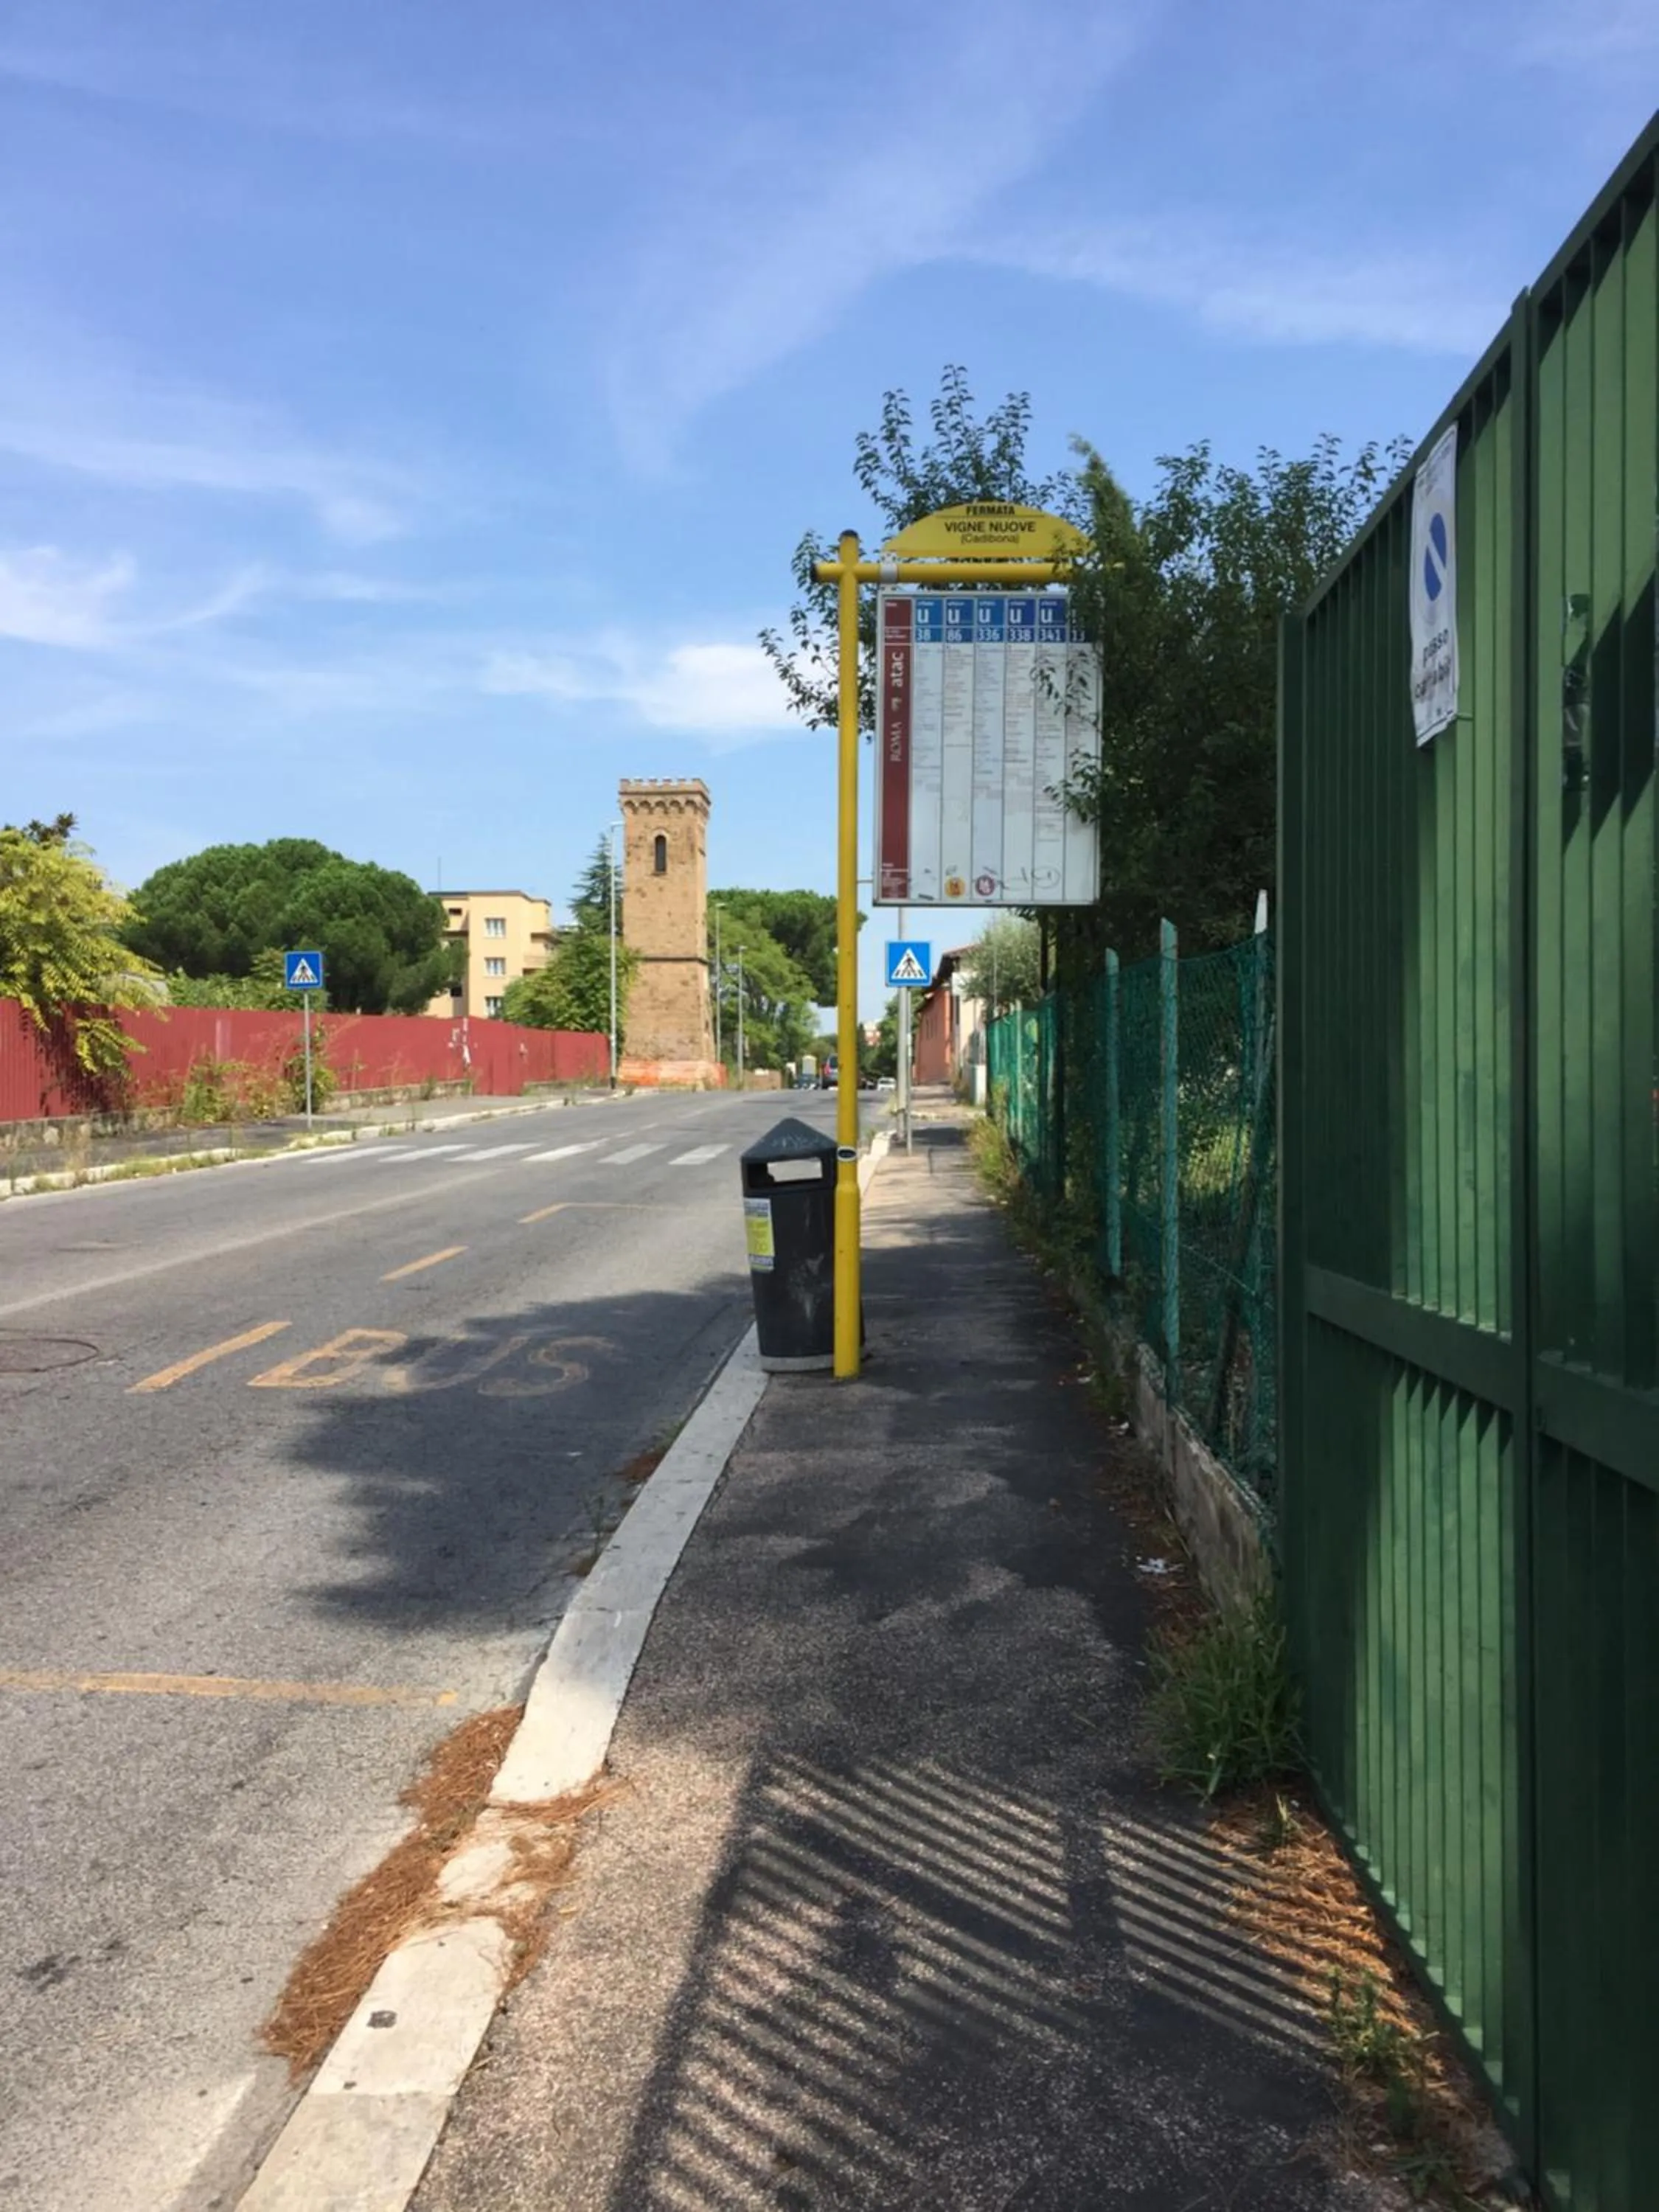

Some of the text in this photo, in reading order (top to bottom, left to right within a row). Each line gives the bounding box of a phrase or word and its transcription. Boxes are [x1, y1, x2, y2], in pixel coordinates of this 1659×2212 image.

[966, 505, 1015, 515] FERMATA
[945, 521, 1036, 532] VIGNE NUOVE
[961, 533, 1020, 544] (Cadibona)
[917, 628, 931, 641] 38
[947, 628, 962, 641] 86
[978, 628, 1001, 641] 336
[1009, 628, 1032, 641] 338
[1040, 628, 1062, 641] 341
[890, 651, 904, 688] atac
[889, 722, 902, 762] ROMA
[247, 1328, 616, 1397] BUS
